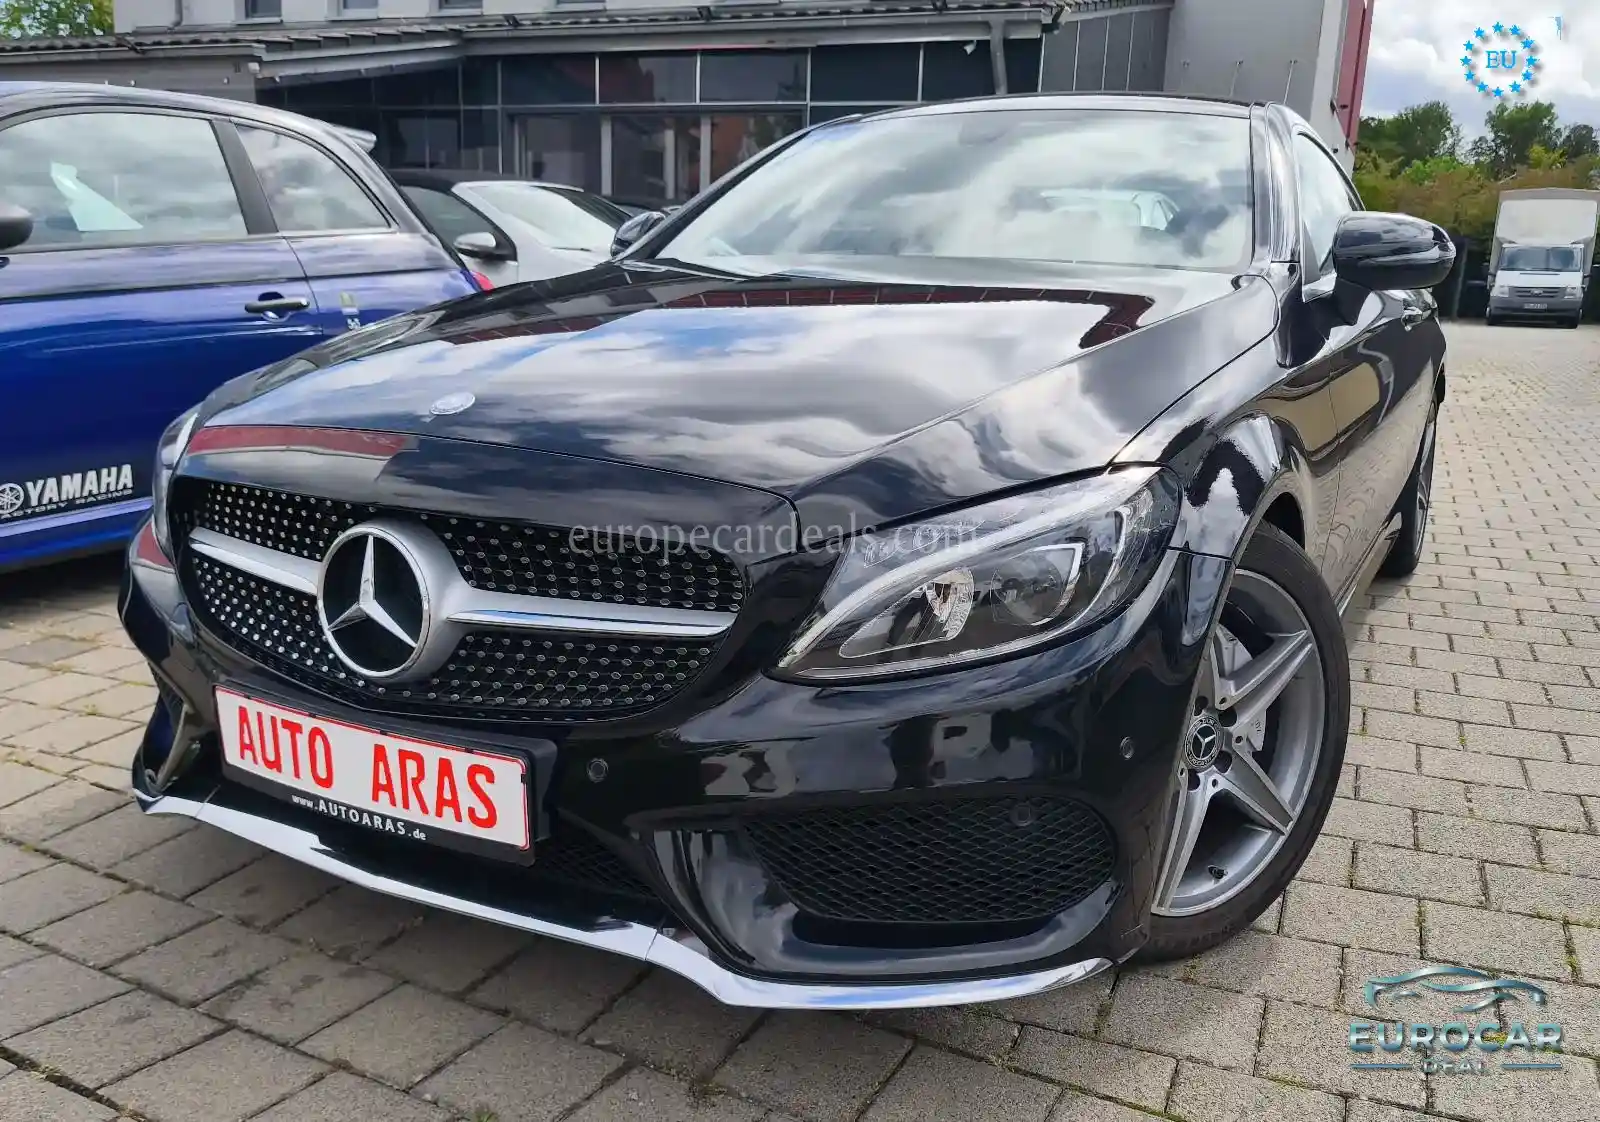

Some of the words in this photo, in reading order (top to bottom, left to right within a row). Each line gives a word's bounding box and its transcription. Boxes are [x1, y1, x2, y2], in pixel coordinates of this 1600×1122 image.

[25, 464, 134, 507] YAMAHA
[0, 500, 68, 519] ACTORY
[238, 705, 334, 790] AUTO
[371, 743, 498, 829] ARAS
[291, 794, 427, 841] www.AUTOARAS.de
